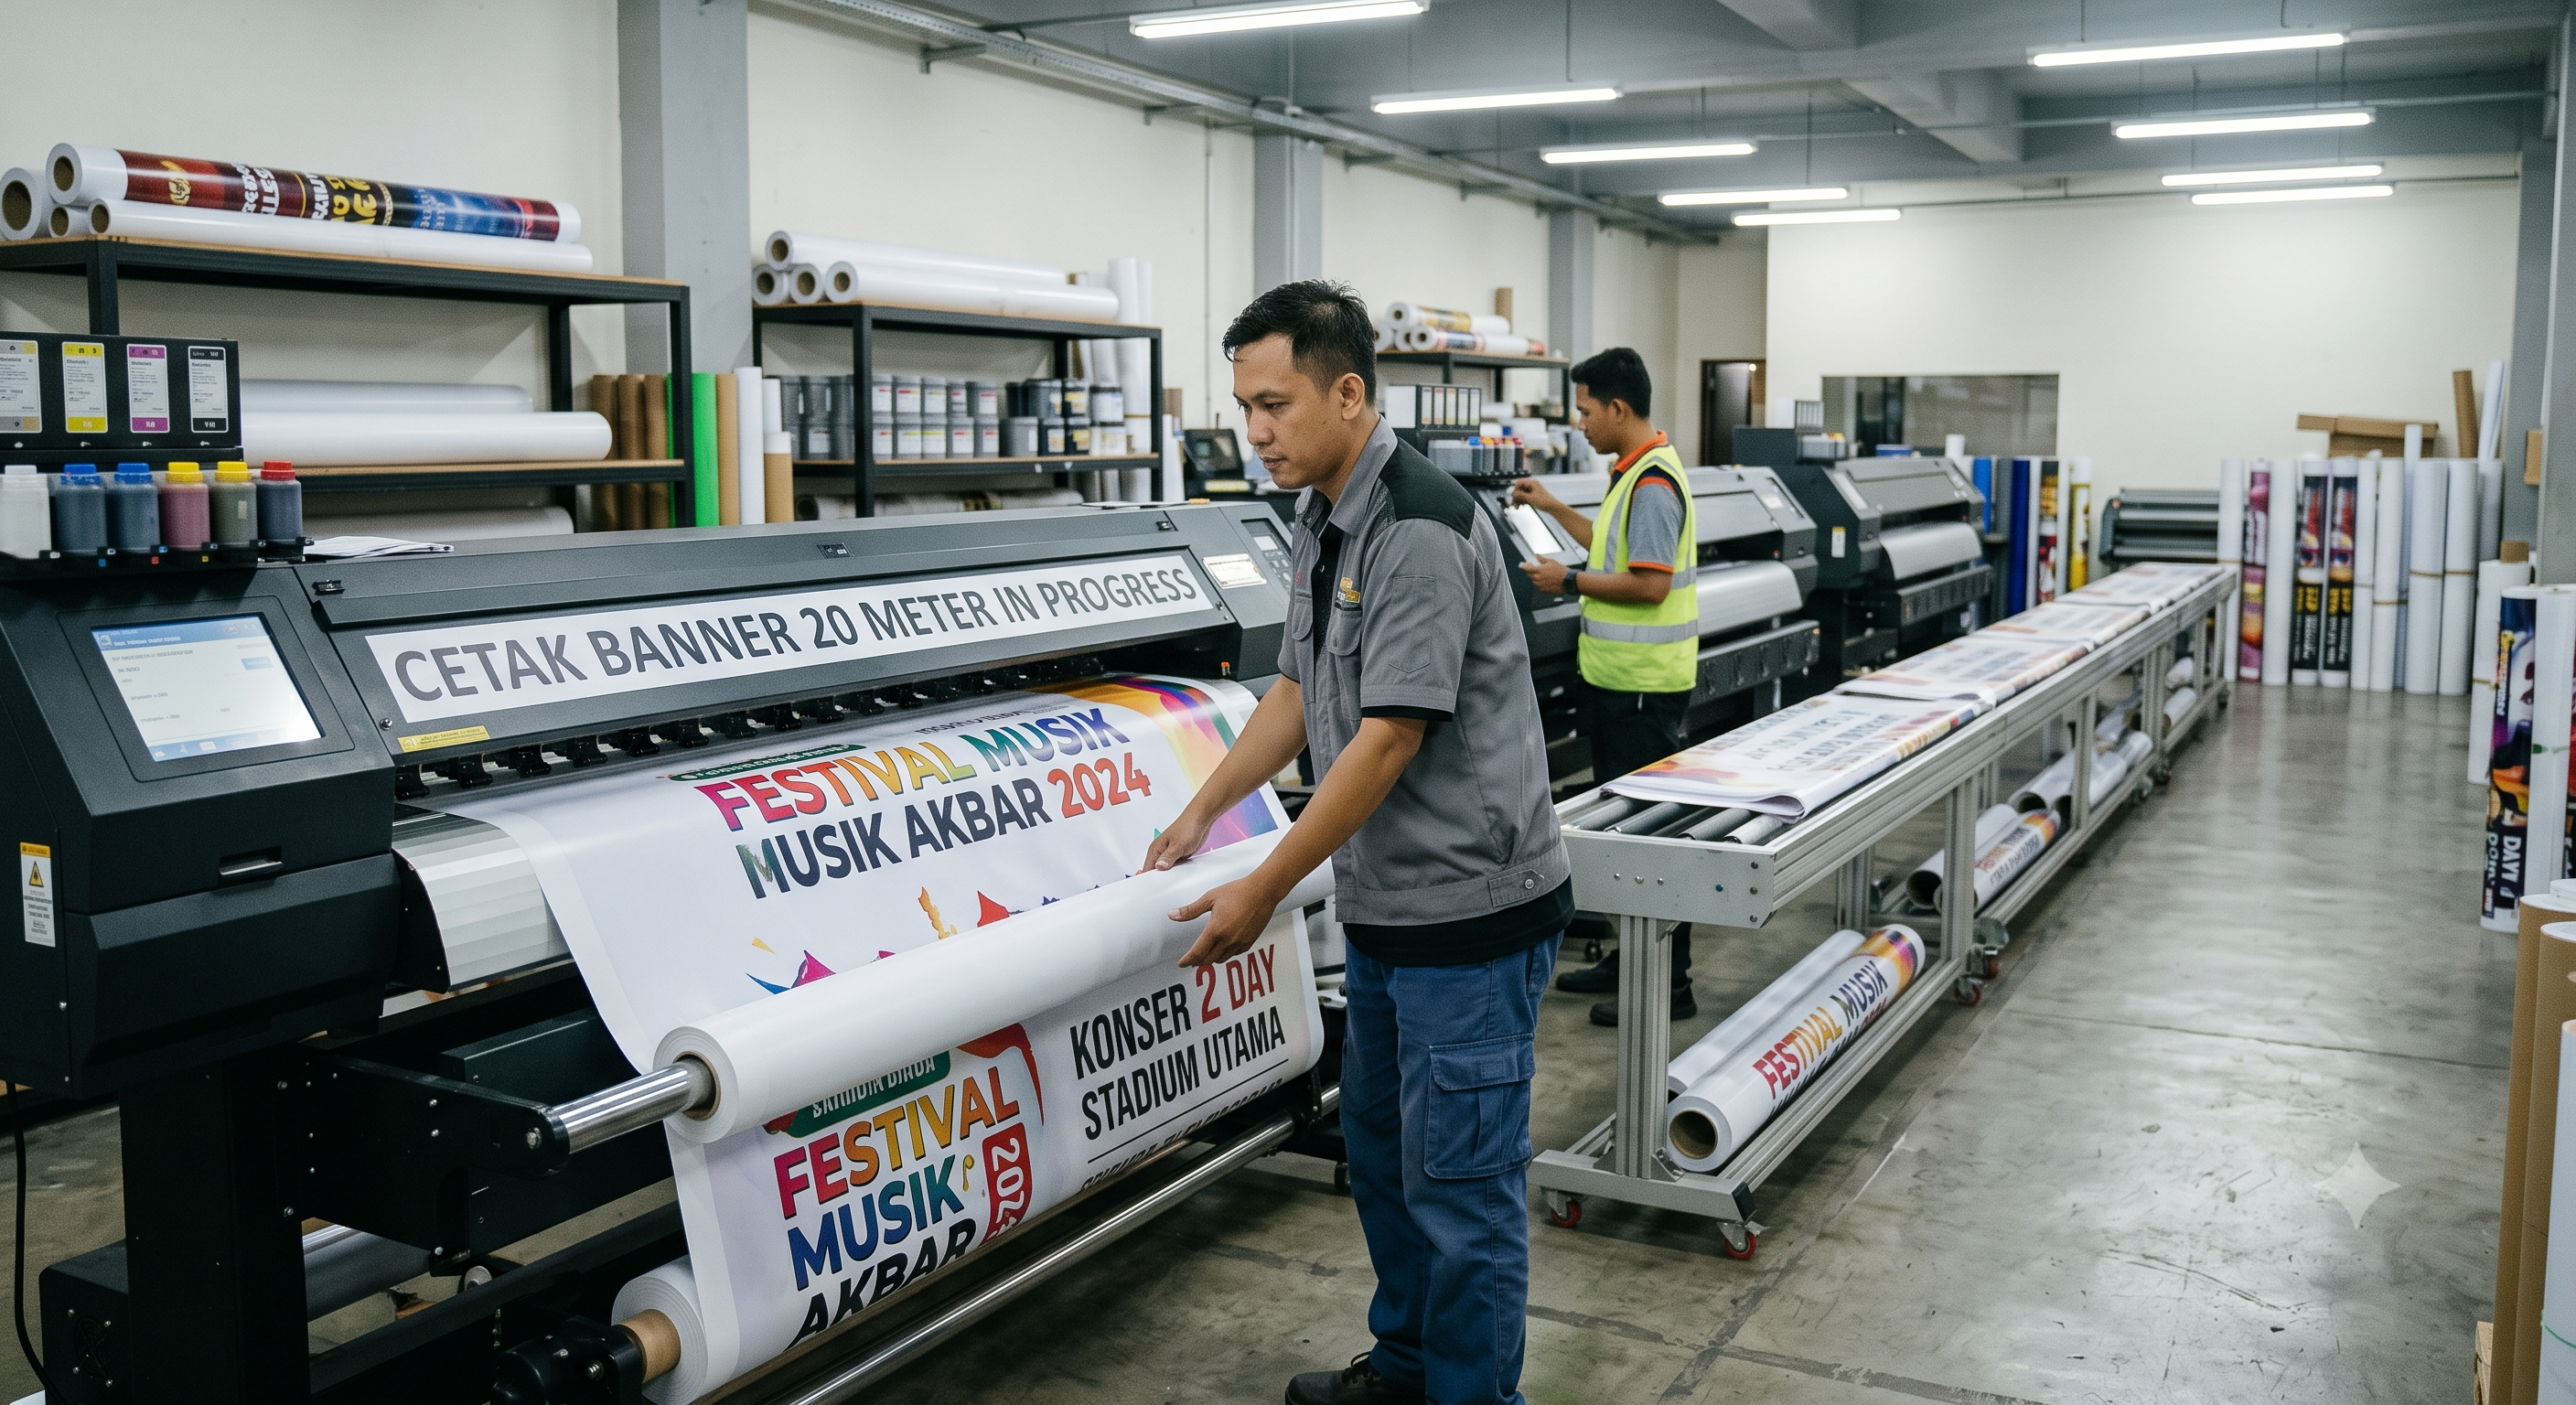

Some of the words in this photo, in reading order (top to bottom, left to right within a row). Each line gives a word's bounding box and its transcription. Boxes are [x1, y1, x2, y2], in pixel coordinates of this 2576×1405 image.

[394, 633, 588, 702] CETAK
[585, 612, 802, 677] BANNER
[799, 604, 858, 649] 20
[857, 590, 999, 641] METER
[992, 584, 1041, 624] IN
[1036, 568, 1197, 617] PROGRESS
[692, 741, 978, 832] FESTIVAL
[957, 707, 1131, 773] MUSIK
[735, 811, 903, 900] MUSIK
[904, 778, 1054, 859] AKBAR
[1046, 751, 1153, 820] 2024
[1069, 982, 1192, 1081] KONSER
[1195, 962, 1222, 1024] 2
[1225, 943, 1275, 1012] DAY
[1081, 1044, 1201, 1141] STADIUM
[1203, 1004, 1286, 1080] UTAMA
[1752, 1006, 1843, 1100] FESTIVAL
[1829, 960, 1889, 1027] MUSIK
[774, 1066, 1021, 1220] FESTIVAL
[781, 1217, 977, 1353] AKBAR
[787, 1153, 966, 1292] MUSIK
